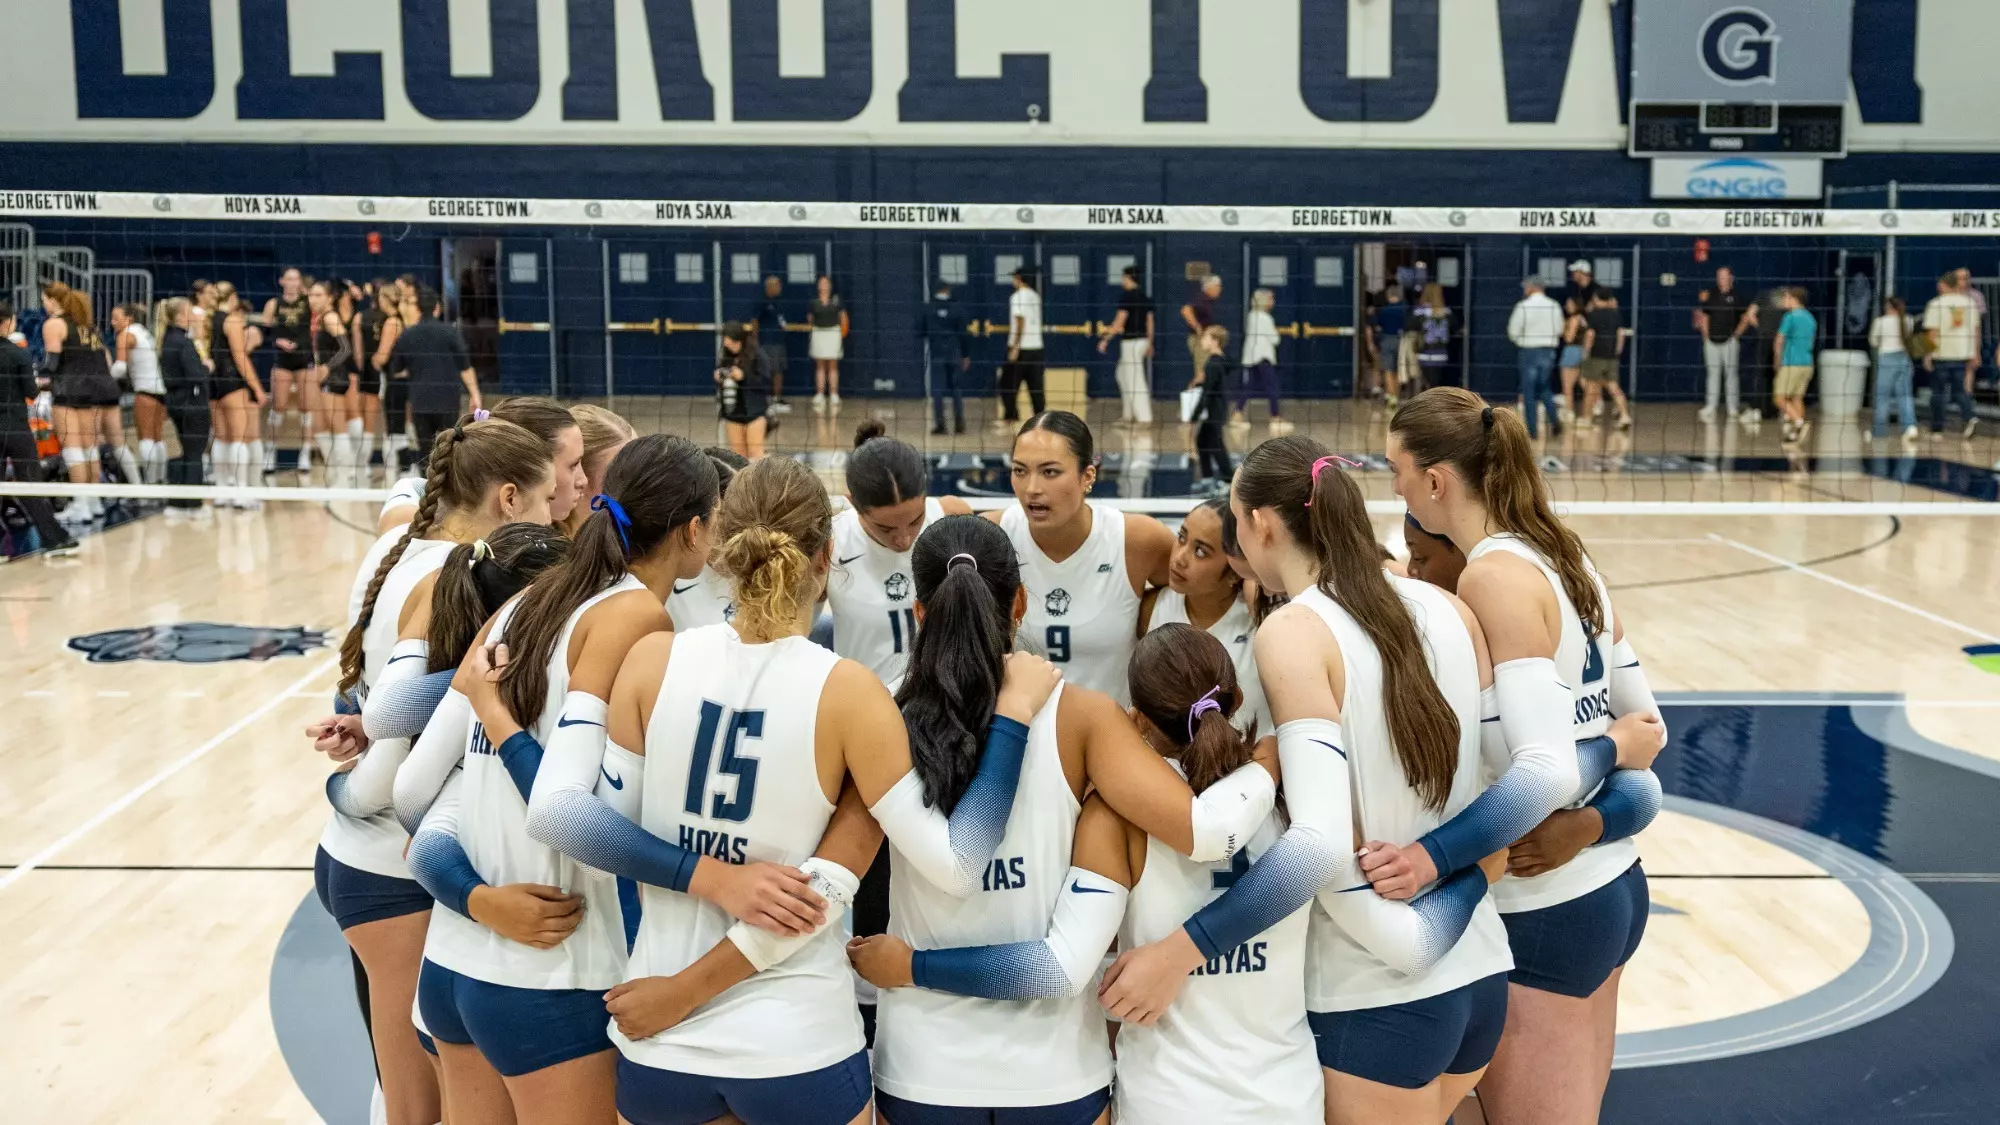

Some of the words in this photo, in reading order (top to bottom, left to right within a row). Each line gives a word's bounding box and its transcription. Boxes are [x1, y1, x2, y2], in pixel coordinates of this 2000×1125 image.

[1698, 6, 1781, 86] G
[225, 197, 260, 213] HOYA
[264, 198, 301, 214] SAXA
[428, 200, 528, 217] GEORGETOWN
[656, 203, 691, 219] HOYA
[696, 204, 732, 220] SAXA
[860, 206, 960, 223] GEORGETOWN
[1088, 208, 1123, 224] HOYA
[1128, 209, 1164, 225] SAXA
[1292, 210, 1392, 226] GEORGETOWN
[1520, 211, 1555, 227] HOYA
[1559, 212, 1596, 227] SAXA
[1724, 212, 1824, 228] GEORGETOWN
[1951, 212, 1987, 228] HOYA
[1045, 625, 1071, 663] 9
[683, 697, 768, 824] 15
[679, 824, 748, 865] HOYAS
[982, 856, 1026, 891] YAS
[1188, 942, 1267, 976] OYAS
